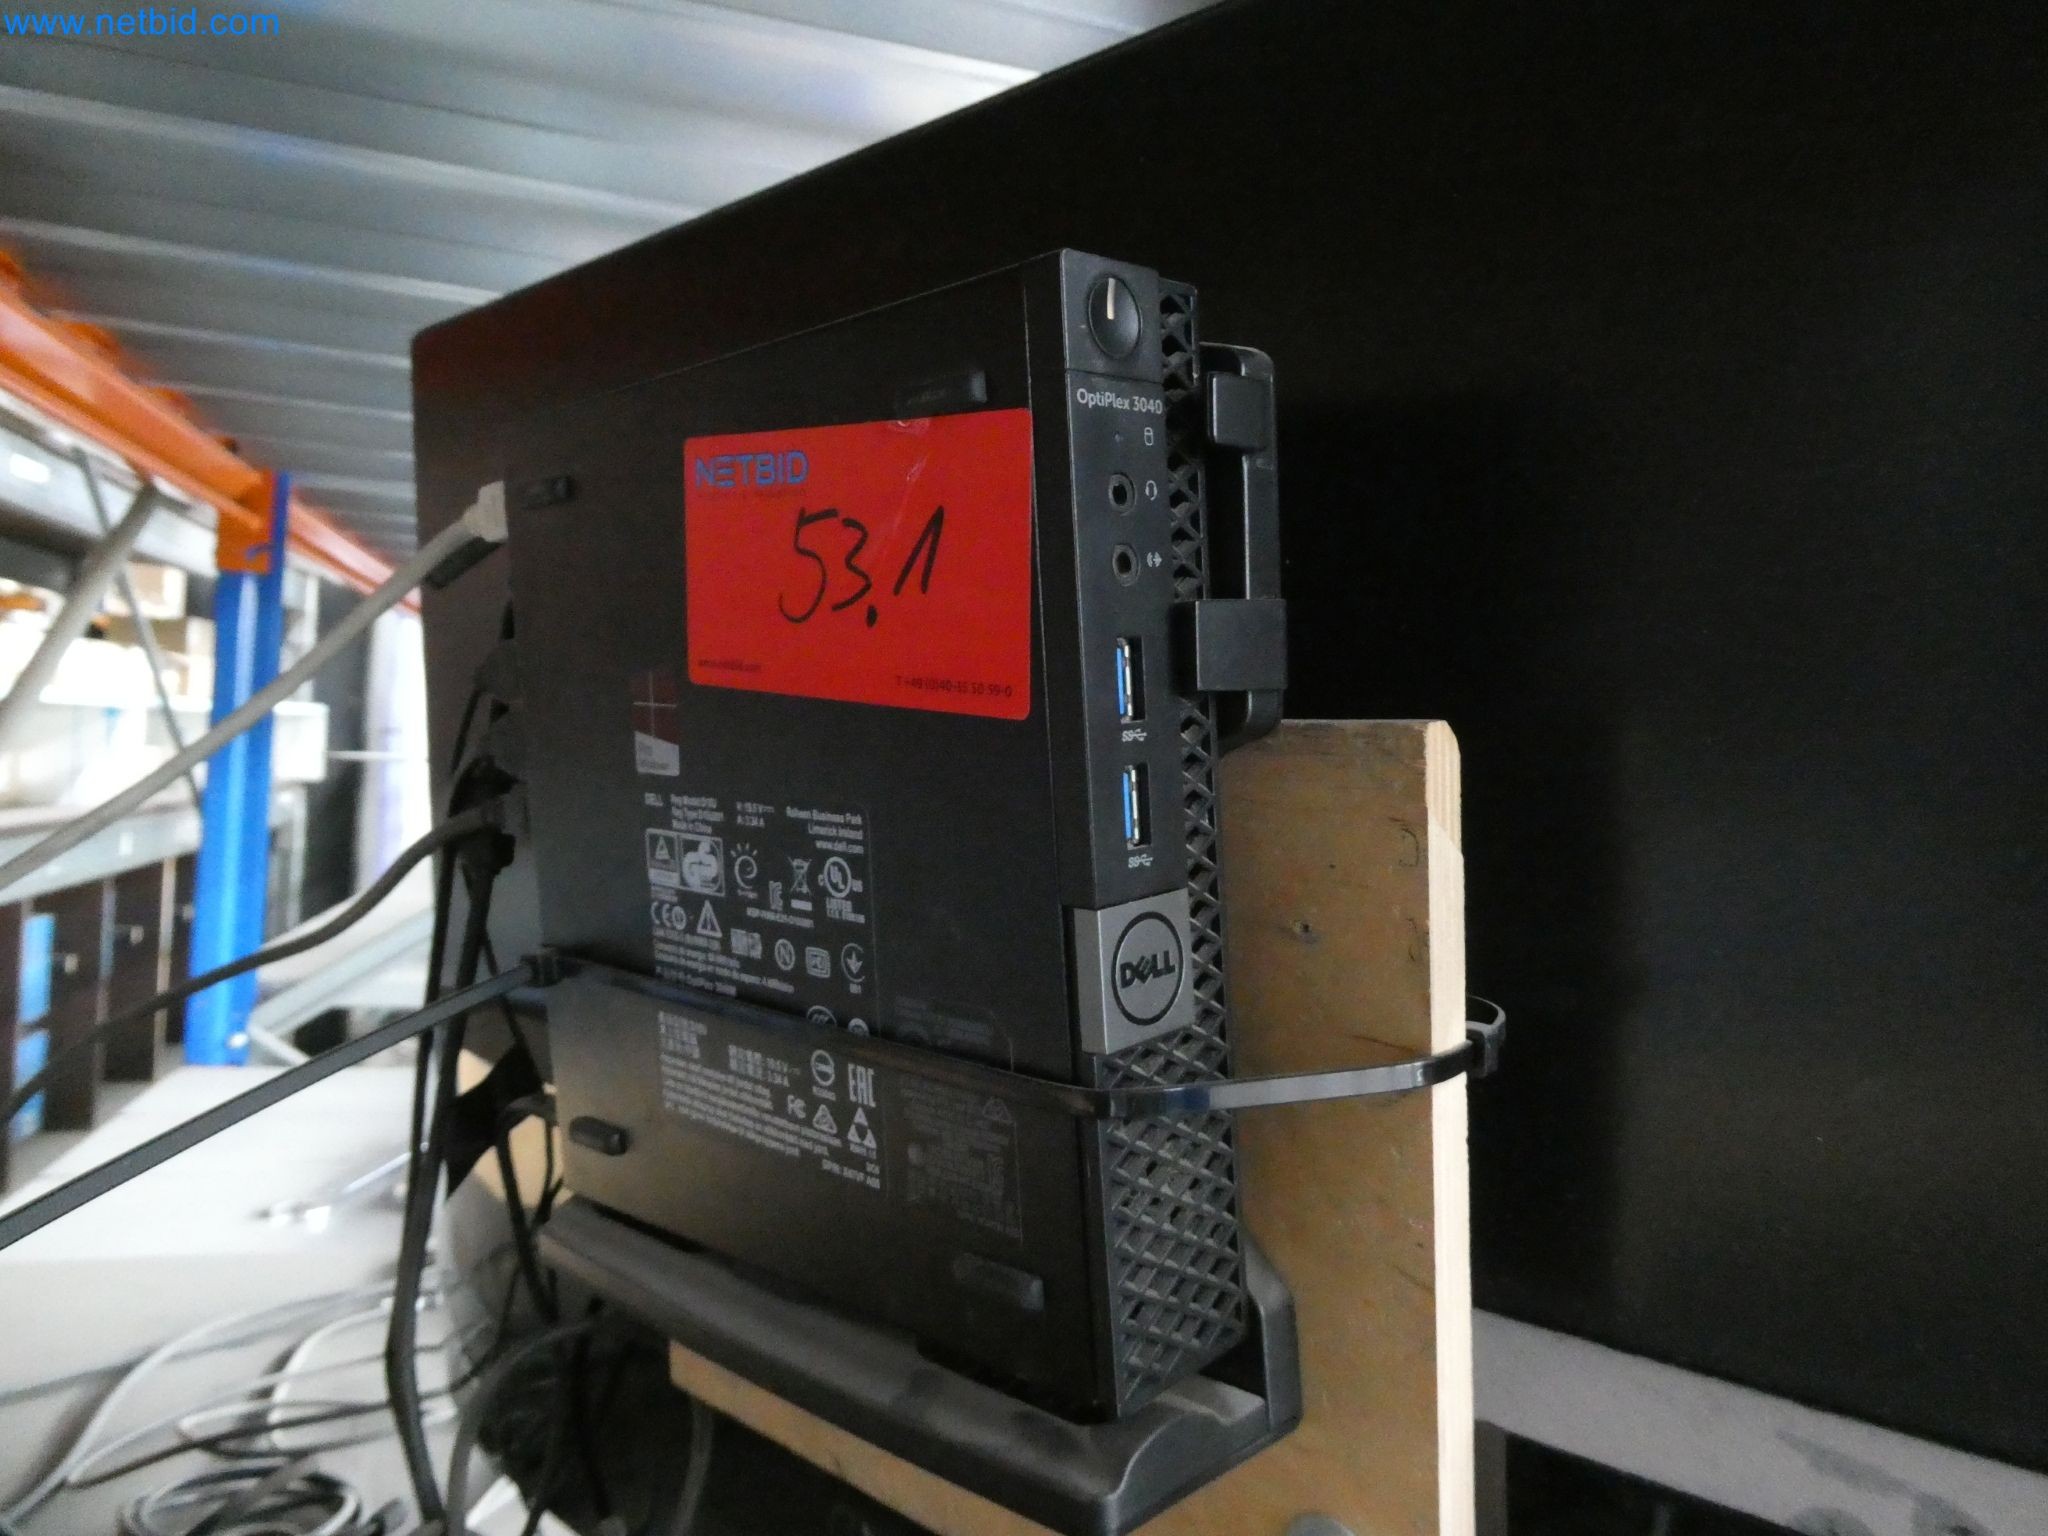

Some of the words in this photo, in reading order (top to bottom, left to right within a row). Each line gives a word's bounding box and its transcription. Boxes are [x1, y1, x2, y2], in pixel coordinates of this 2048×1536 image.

[1076, 388, 1130, 409] OptiPlex
[1132, 396, 1163, 414] 3040
[695, 450, 810, 488] NETBID
[779, 504, 945, 628] 53.1
[1120, 950, 1176, 990] DELL
